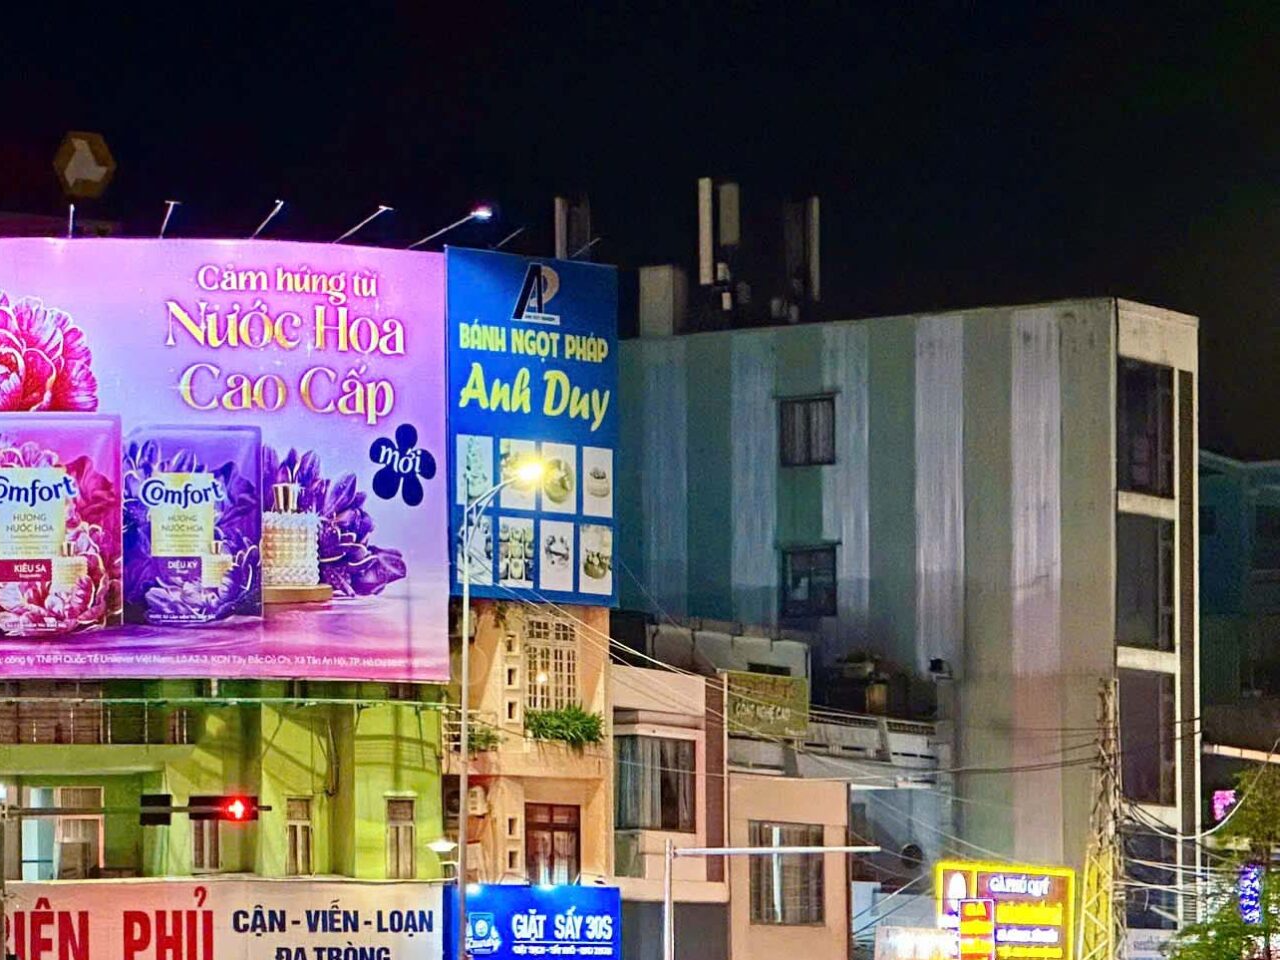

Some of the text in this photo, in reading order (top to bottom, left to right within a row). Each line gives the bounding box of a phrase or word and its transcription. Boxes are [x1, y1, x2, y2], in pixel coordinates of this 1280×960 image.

[197, 264, 377, 305] Cảm hứng từ
[165, 300, 405, 355] Nước Hoa
[459, 319, 609, 363] BÁNH NGỌT PHÁP
[180, 363, 395, 425] Cao Cấp
[458, 362, 610, 432] Anh Duy
[380, 445, 422, 474] mới
[142, 480, 223, 508] Comfort
[232, 904, 286, 936] CẬN
[305, 900, 359, 932] VIỄN
[376, 910, 433, 937] LOẠN
[554, 905, 583, 940] SẤY
